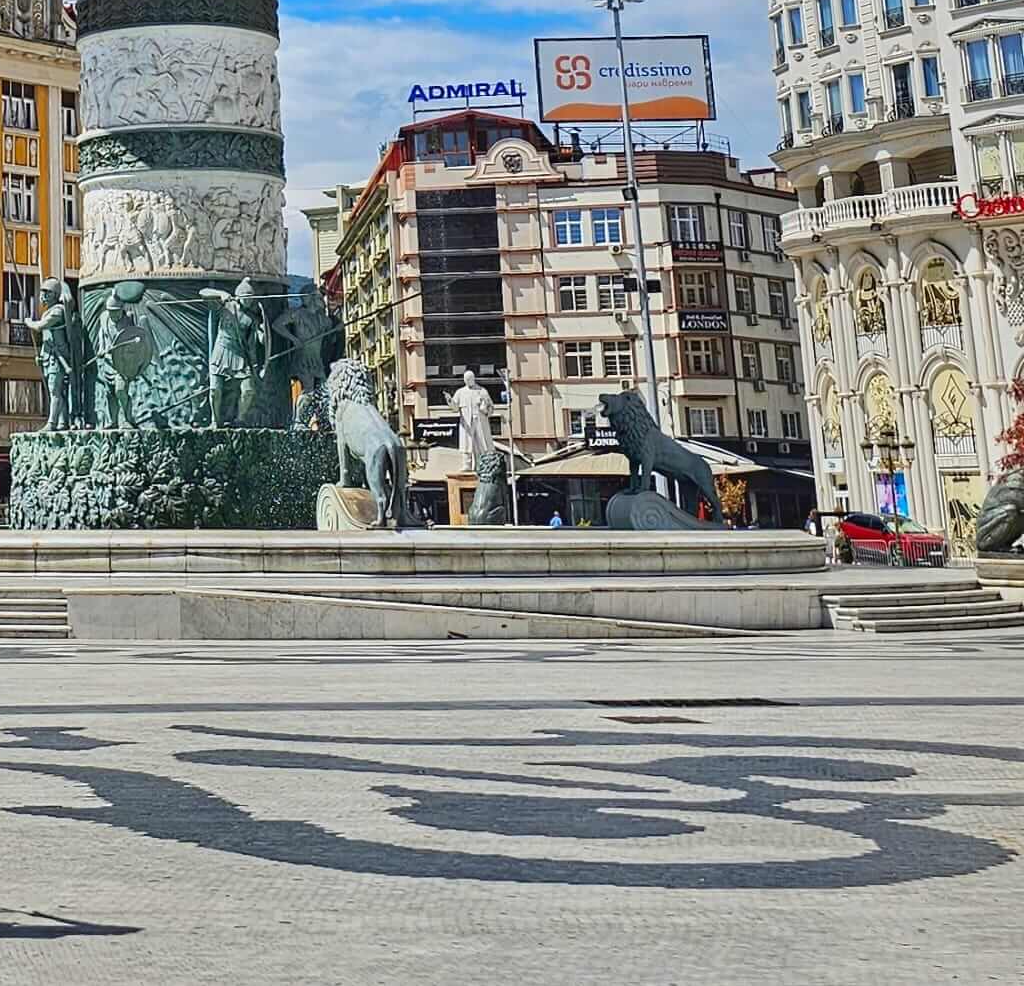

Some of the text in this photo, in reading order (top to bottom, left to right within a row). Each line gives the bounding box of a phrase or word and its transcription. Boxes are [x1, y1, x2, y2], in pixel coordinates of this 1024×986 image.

[408, 79, 527, 102] ADMIRAL
[681, 320, 727, 329] LONDON
[588, 438, 621, 447] LOND
